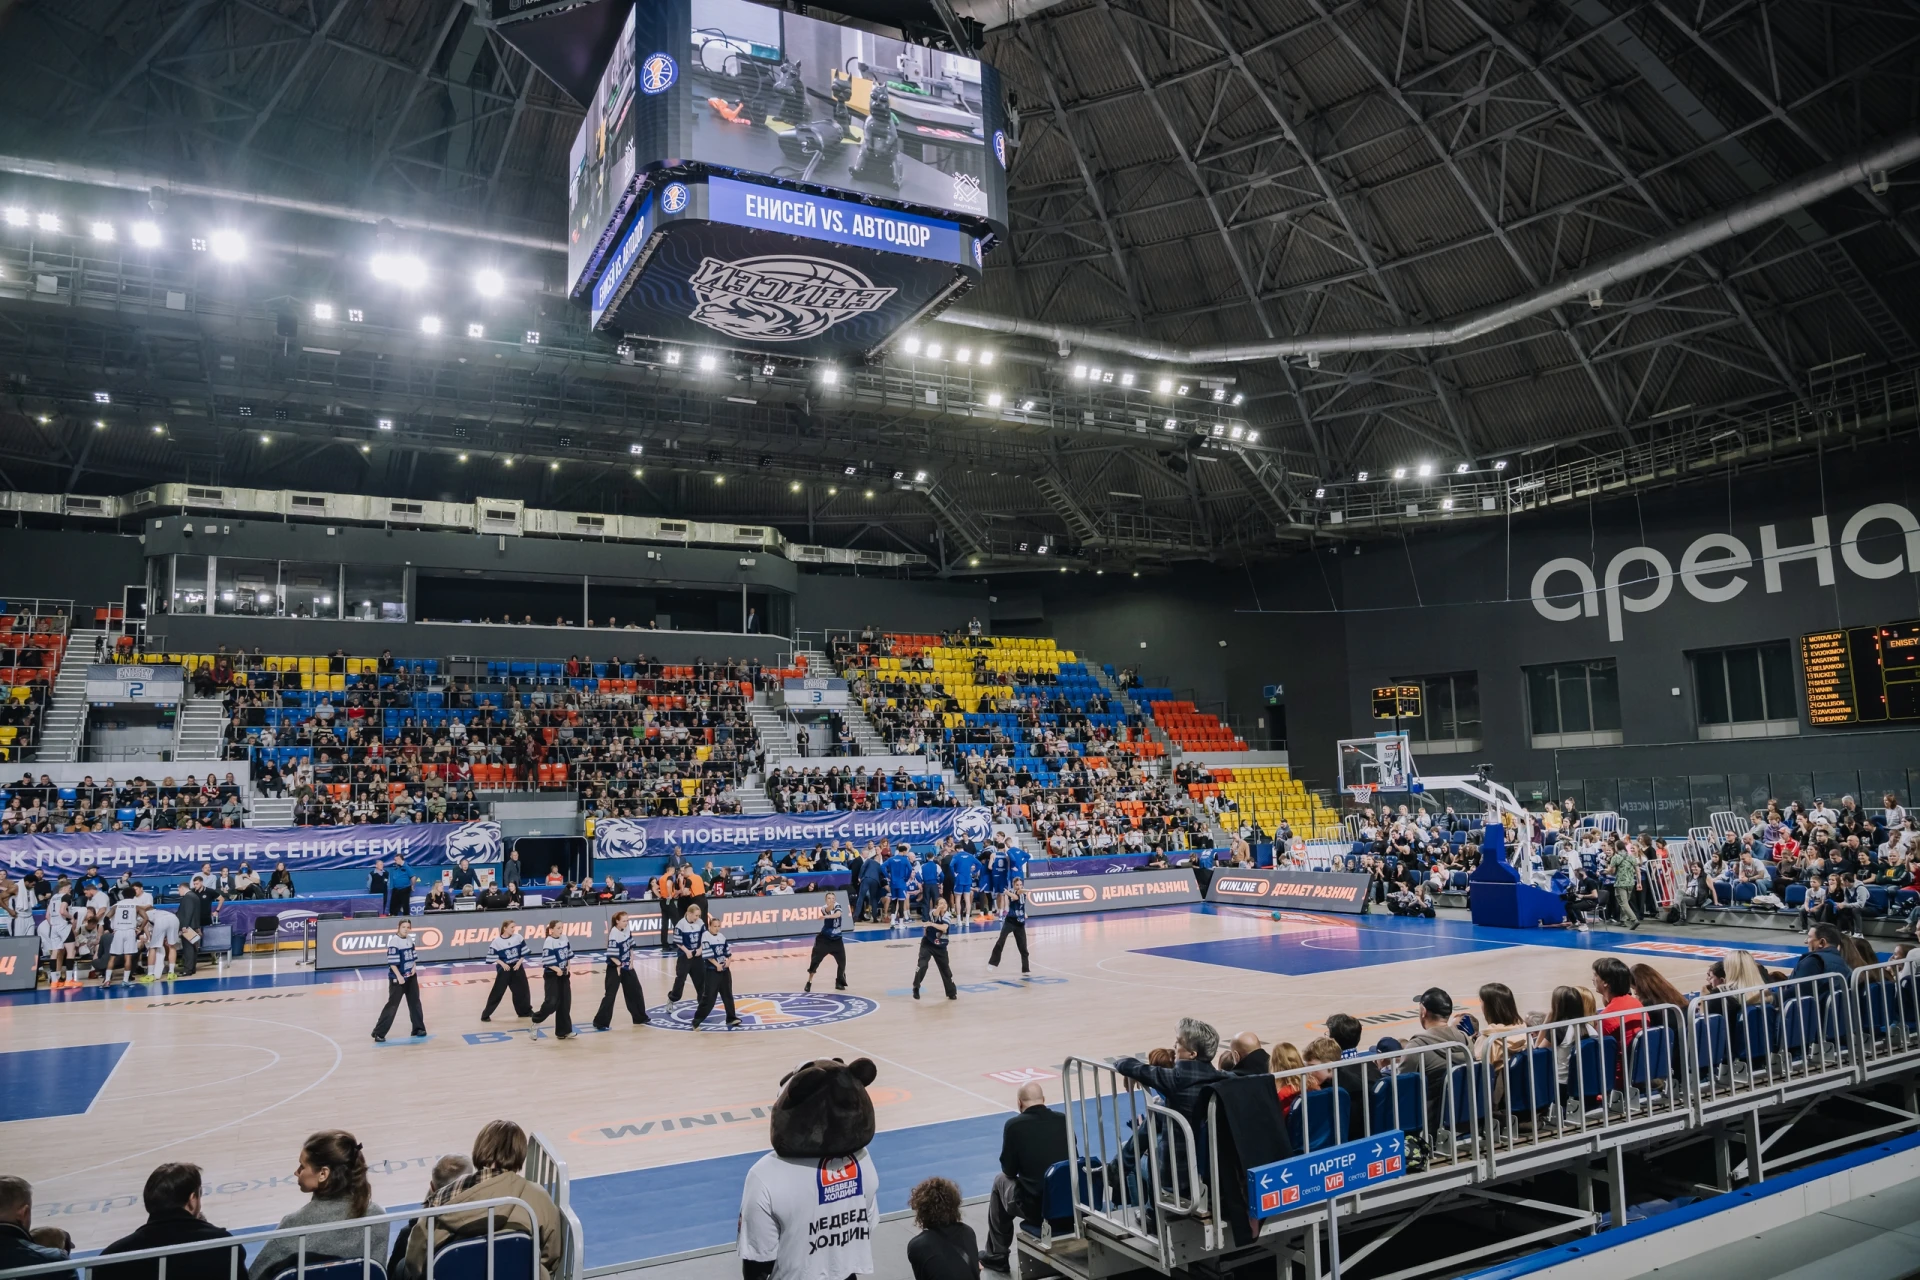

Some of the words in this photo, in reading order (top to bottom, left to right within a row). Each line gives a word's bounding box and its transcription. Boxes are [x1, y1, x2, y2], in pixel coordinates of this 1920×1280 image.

[745, 193, 816, 228] ЕНИСЕЙ
[820, 208, 848, 234] VS.
[852, 214, 930, 248] АВТОДОР
[692, 259, 892, 312] ЕНИСЕЙ
[1531, 503, 1920, 642] арена
[1809, 633, 1842, 642] MOTOVILOV
[1890, 638, 1919, 648] ENISEY
[116, 666, 155, 680] ENISEY
[130, 682, 144, 698] 2
[812, 691, 822, 702] 3
[663, 829, 678, 844] К
[682, 826, 759, 845] ПОБЕДЕ
[765, 824, 835, 842] ВМЕСТЕ
[838, 824, 850, 837] С
[854, 820, 940, 837] ЕНИСЕЕМ!
[10, 850, 28, 868] К
[36, 847, 150, 868] ПОБЕДЕ
[157, 843, 259, 863] ВМЕСТЕ
[264, 842, 280, 858] С
[287, 838, 410, 859] ЕНИСЕЕМ!
[716, 883, 723, 895] 5
[1102, 884, 1145, 900] ДЕЛАЕТ
[1146, 880, 1199, 895] РАЗНИЦ
[1219, 880, 1257, 892] WINLINE
[1271, 882, 1314, 897] ДЕЛАЕТ
[1032, 889, 1080, 903] WINLINE
[122, 910, 129, 919] 8
[721, 909, 779, 928] ДЕЛАЕТ
[782, 906, 823, 921] РАЗН
[451, 925, 522, 946] ДЕЛАТ
[147, 992, 307, 1008] WINLINE
[601, 1105, 771, 1140] WINLI
[1310, 1152, 1356, 1177] ПАРТЕР
[825, 1180, 857, 1194] МЕДВЕДЬ
[1272, 1194, 1278, 1205] 1
[1291, 1188, 1298, 1199] 2
[1302, 1185, 1321, 1196] сектор
[1326, 1175, 1343, 1188] VIP
[1348, 1171, 1367, 1182] сектор
[1376, 1163, 1383, 1174] 3
[1393, 1157, 1400, 1168] 4
[825, 1187, 857, 1202] ХОЛДИНГ
[809, 1208, 868, 1236] МЕДВЕД
[809, 1227, 869, 1255] ХОЛДИН
